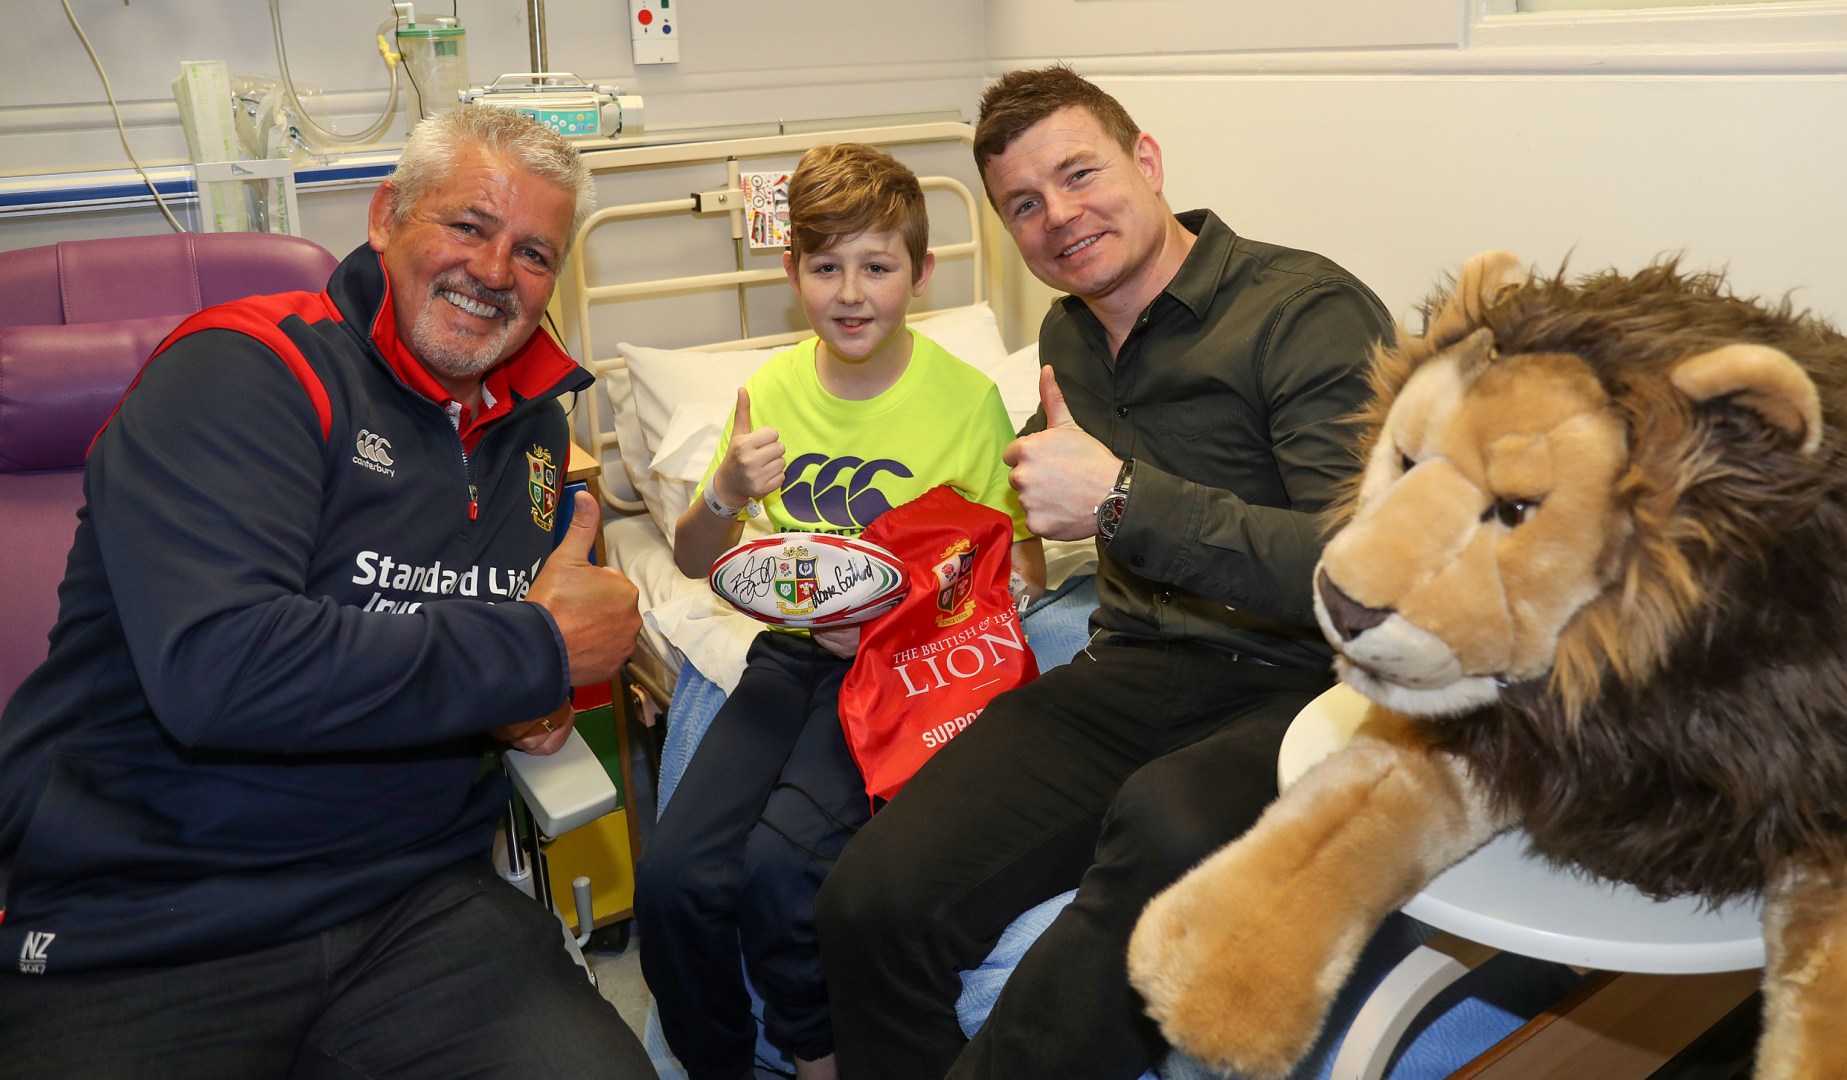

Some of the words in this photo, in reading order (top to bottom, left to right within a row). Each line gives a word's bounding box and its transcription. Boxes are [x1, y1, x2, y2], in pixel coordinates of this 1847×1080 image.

[352, 456, 395, 478] canterbury
[488, 566, 531, 602] Life
[892, 647, 920, 665] THE
[920, 625, 978, 657] BRITISH
[978, 616, 991, 631] &
[893, 618, 1026, 698] LION
[921, 708, 985, 749] SUPPO
[20, 931, 56, 960] NZ
